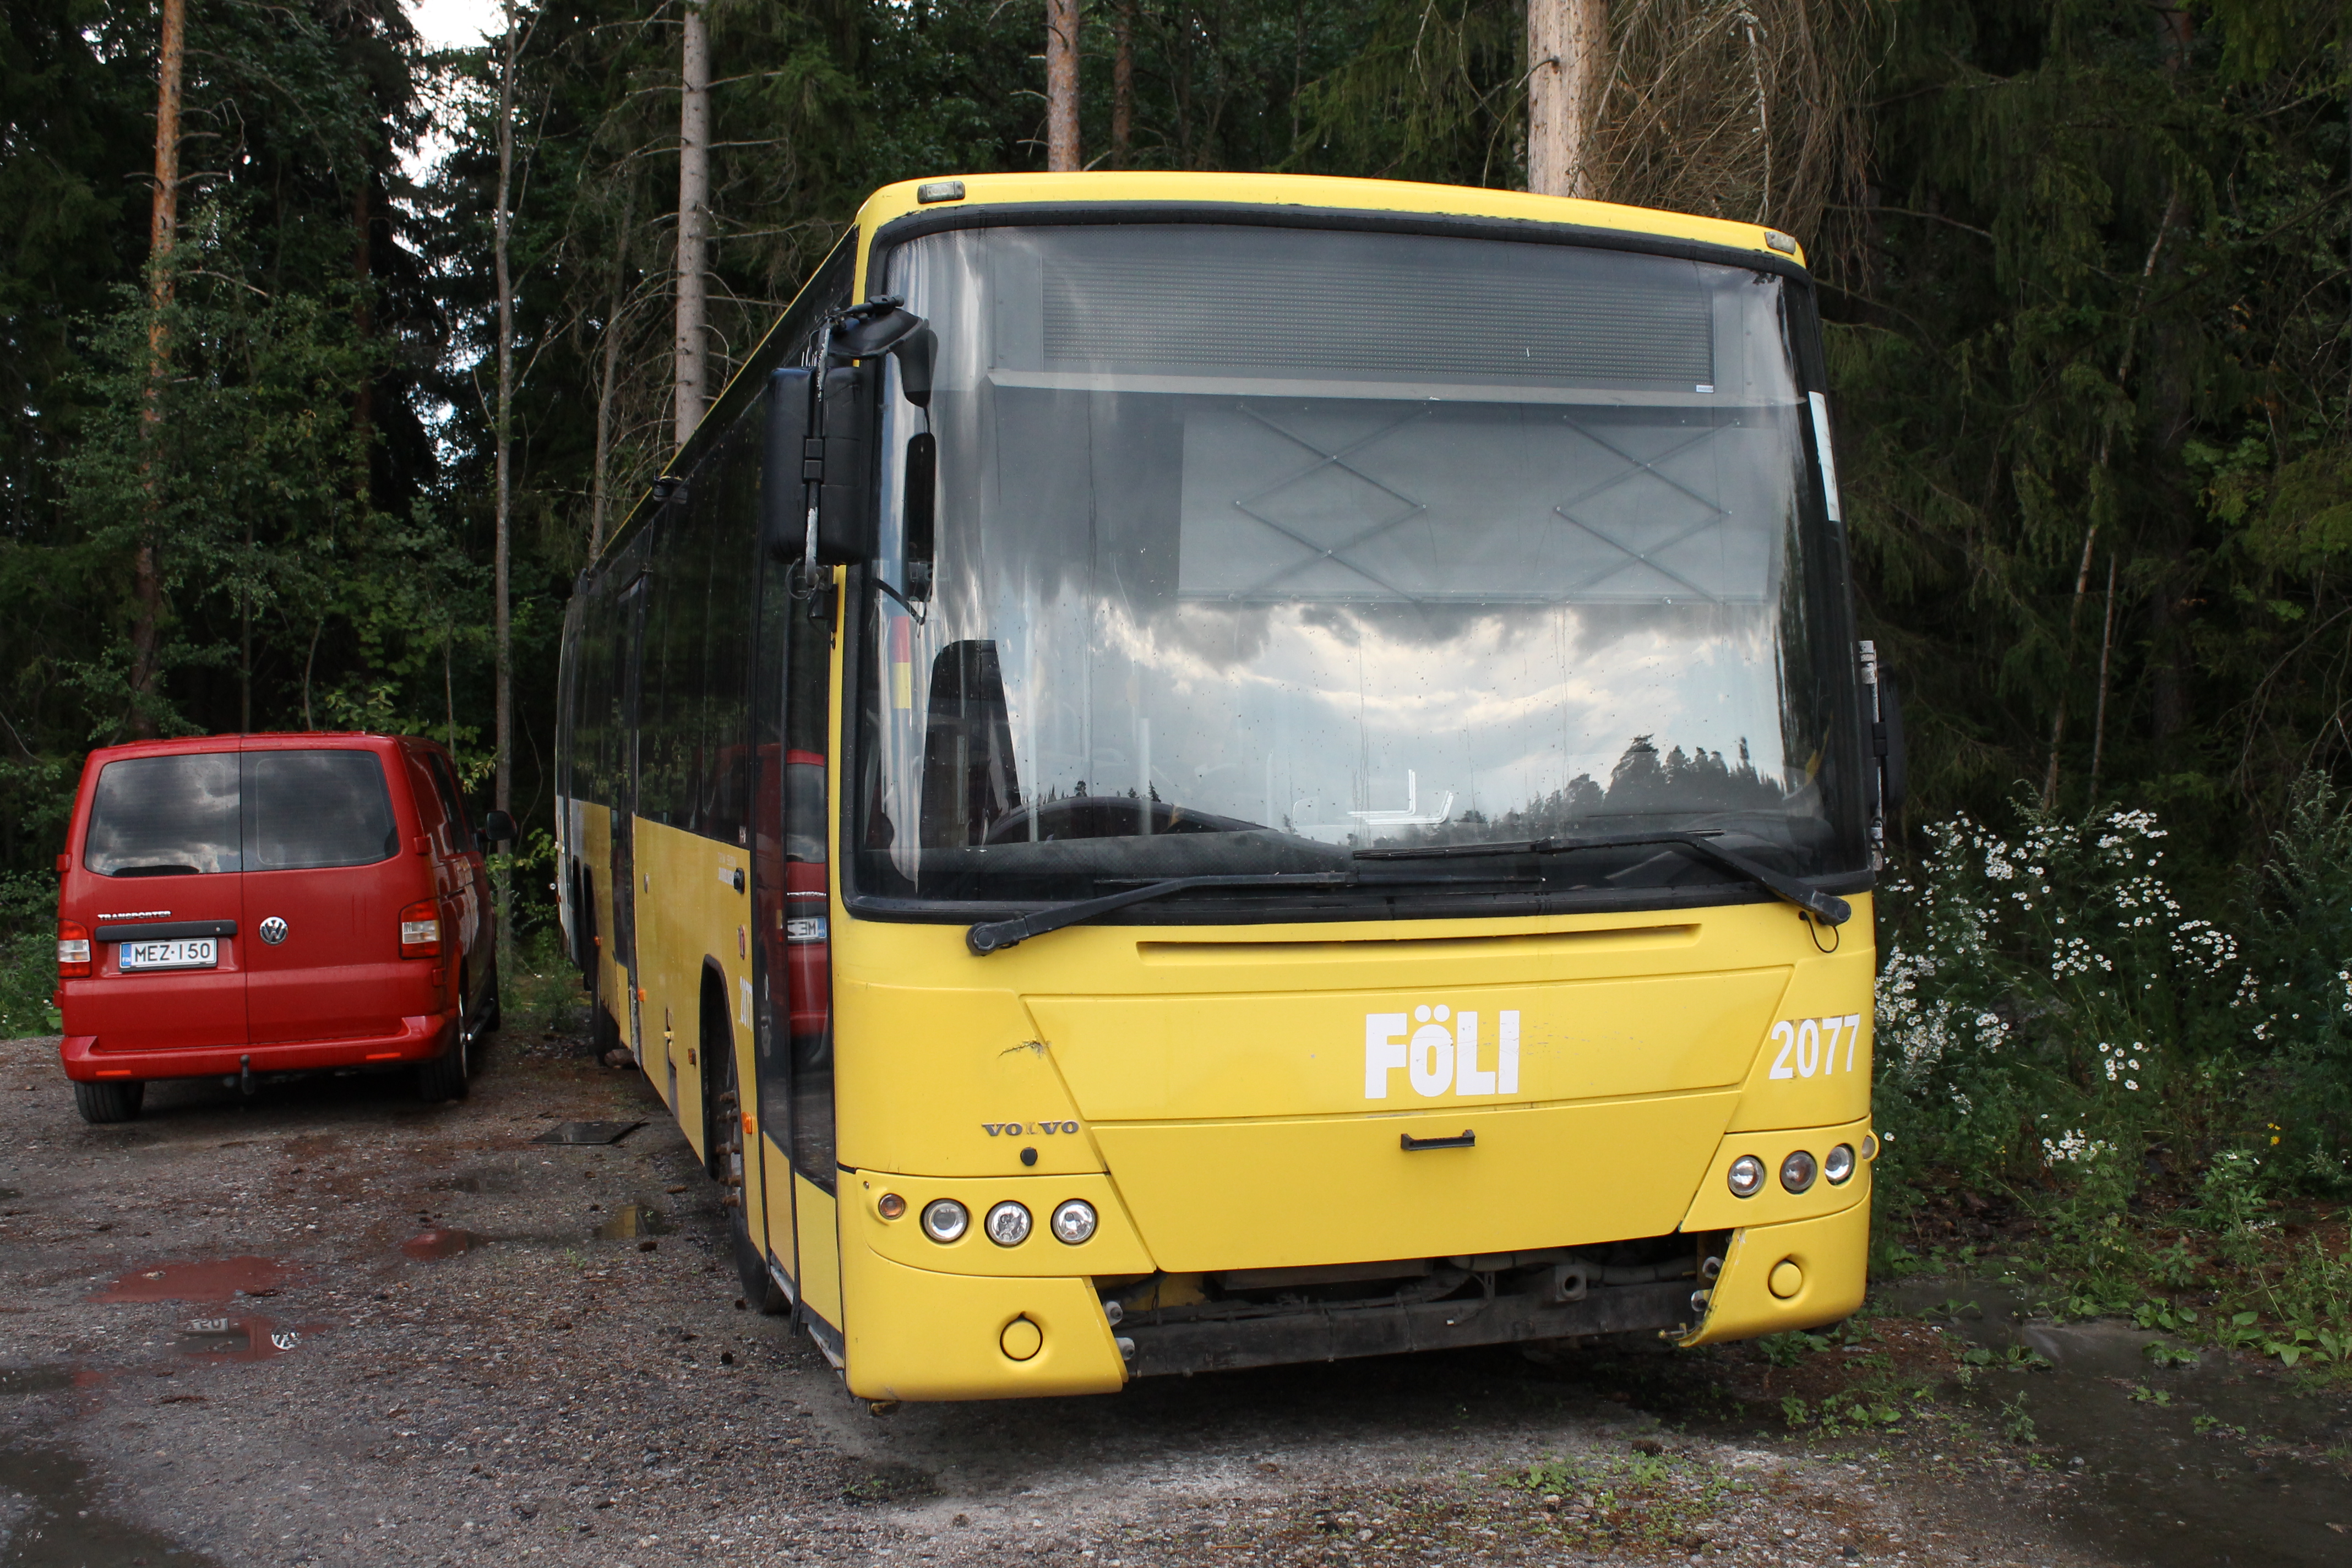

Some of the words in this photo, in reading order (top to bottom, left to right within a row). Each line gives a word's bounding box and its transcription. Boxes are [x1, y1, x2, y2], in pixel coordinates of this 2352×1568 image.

[97, 910, 171, 921] TRANSPORTER
[1365, 1004, 1520, 1099] FÖLI
[1769, 1014, 1860, 1080] 2077
[981, 1120, 1079, 1136] VOLVO
